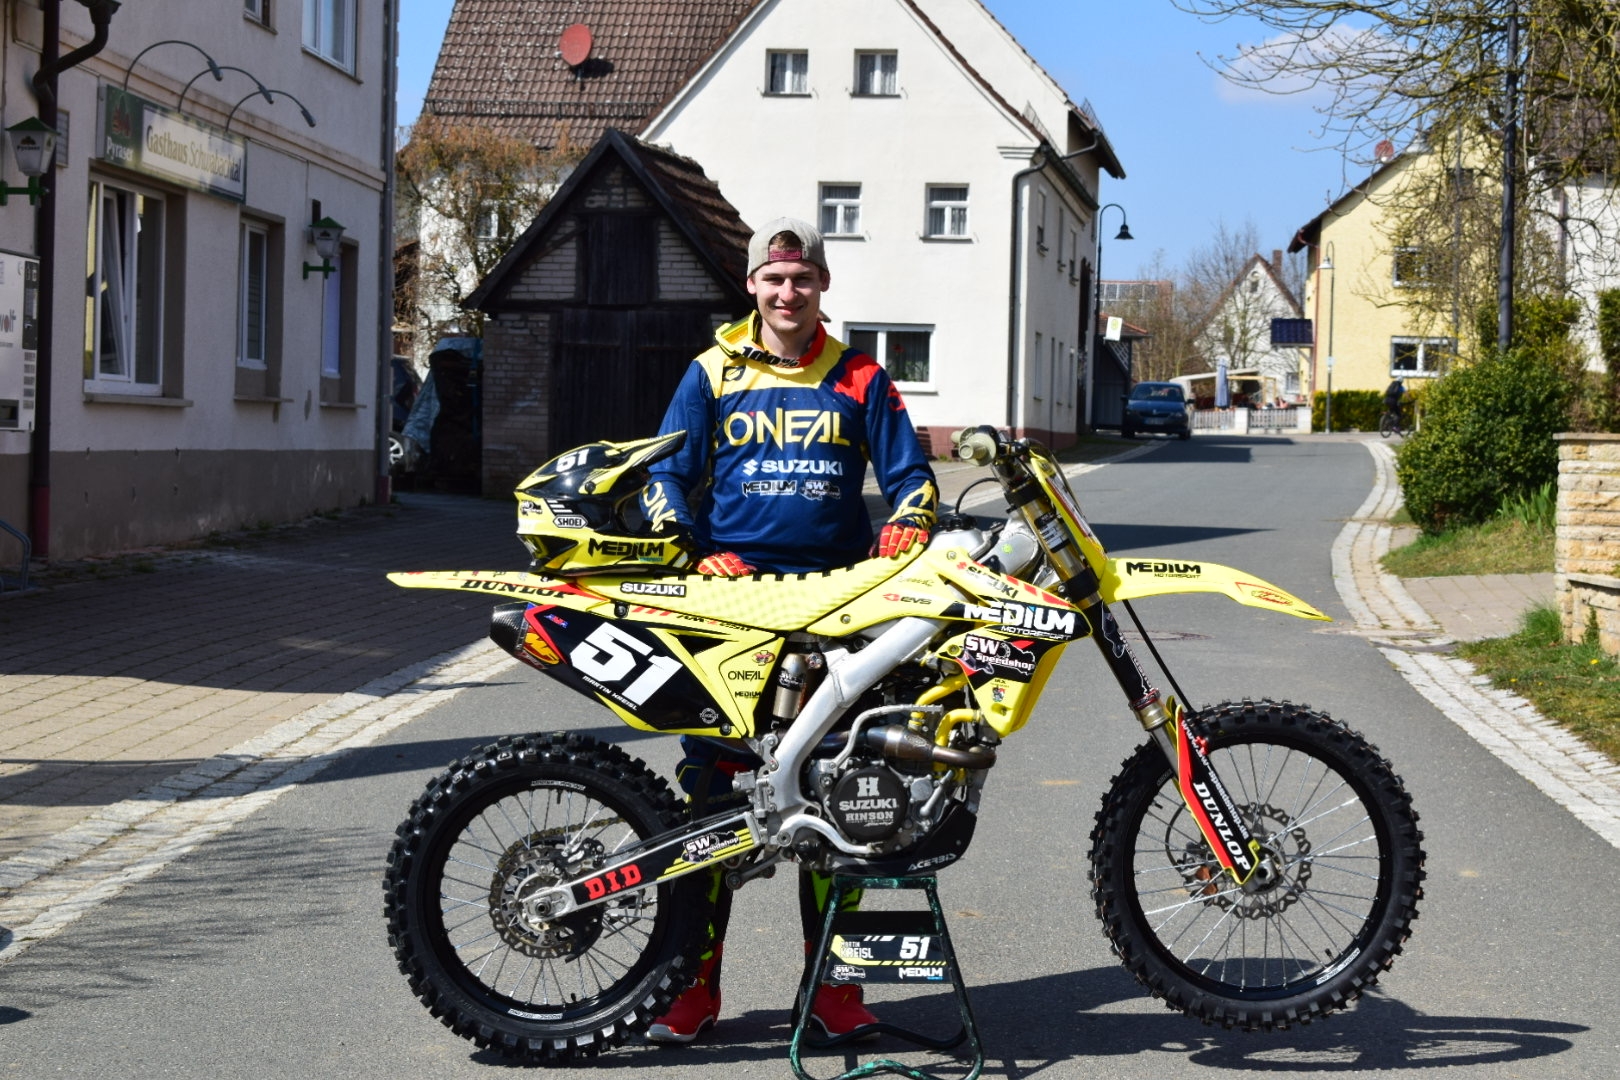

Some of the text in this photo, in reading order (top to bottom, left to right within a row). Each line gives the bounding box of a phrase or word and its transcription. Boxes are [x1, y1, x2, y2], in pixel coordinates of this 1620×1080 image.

[146, 124, 189, 164] Gasthaus
[742, 345, 800, 368] 100%
[556, 448, 590, 473] 51
[760, 459, 843, 476] SUZUKI
[742, 480, 797, 497] MEDIUM
[557, 517, 583, 526] SHOEI
[587, 537, 665, 558] MEDIUM
[1126, 561, 1201, 576] MEDIUM
[460, 579, 577, 599] DUNLOP
[621, 583, 686, 596] SUZUKI
[962, 600, 1076, 635] MEDIUM
[1000, 625, 1072, 640] MOTORSPORT
[965, 635, 1000, 655] SW
[569, 621, 684, 707] 51
[975, 652, 1036, 671] Speedshop
[734, 690, 762, 698] MEDIUM
[839, 798, 898, 811] SUZUKI
[845, 811, 894, 821] HINSON
[1193, 781, 1251, 871] DUNLOP
[840, 947, 874, 959] KREISL
[899, 936, 931, 960] 51
